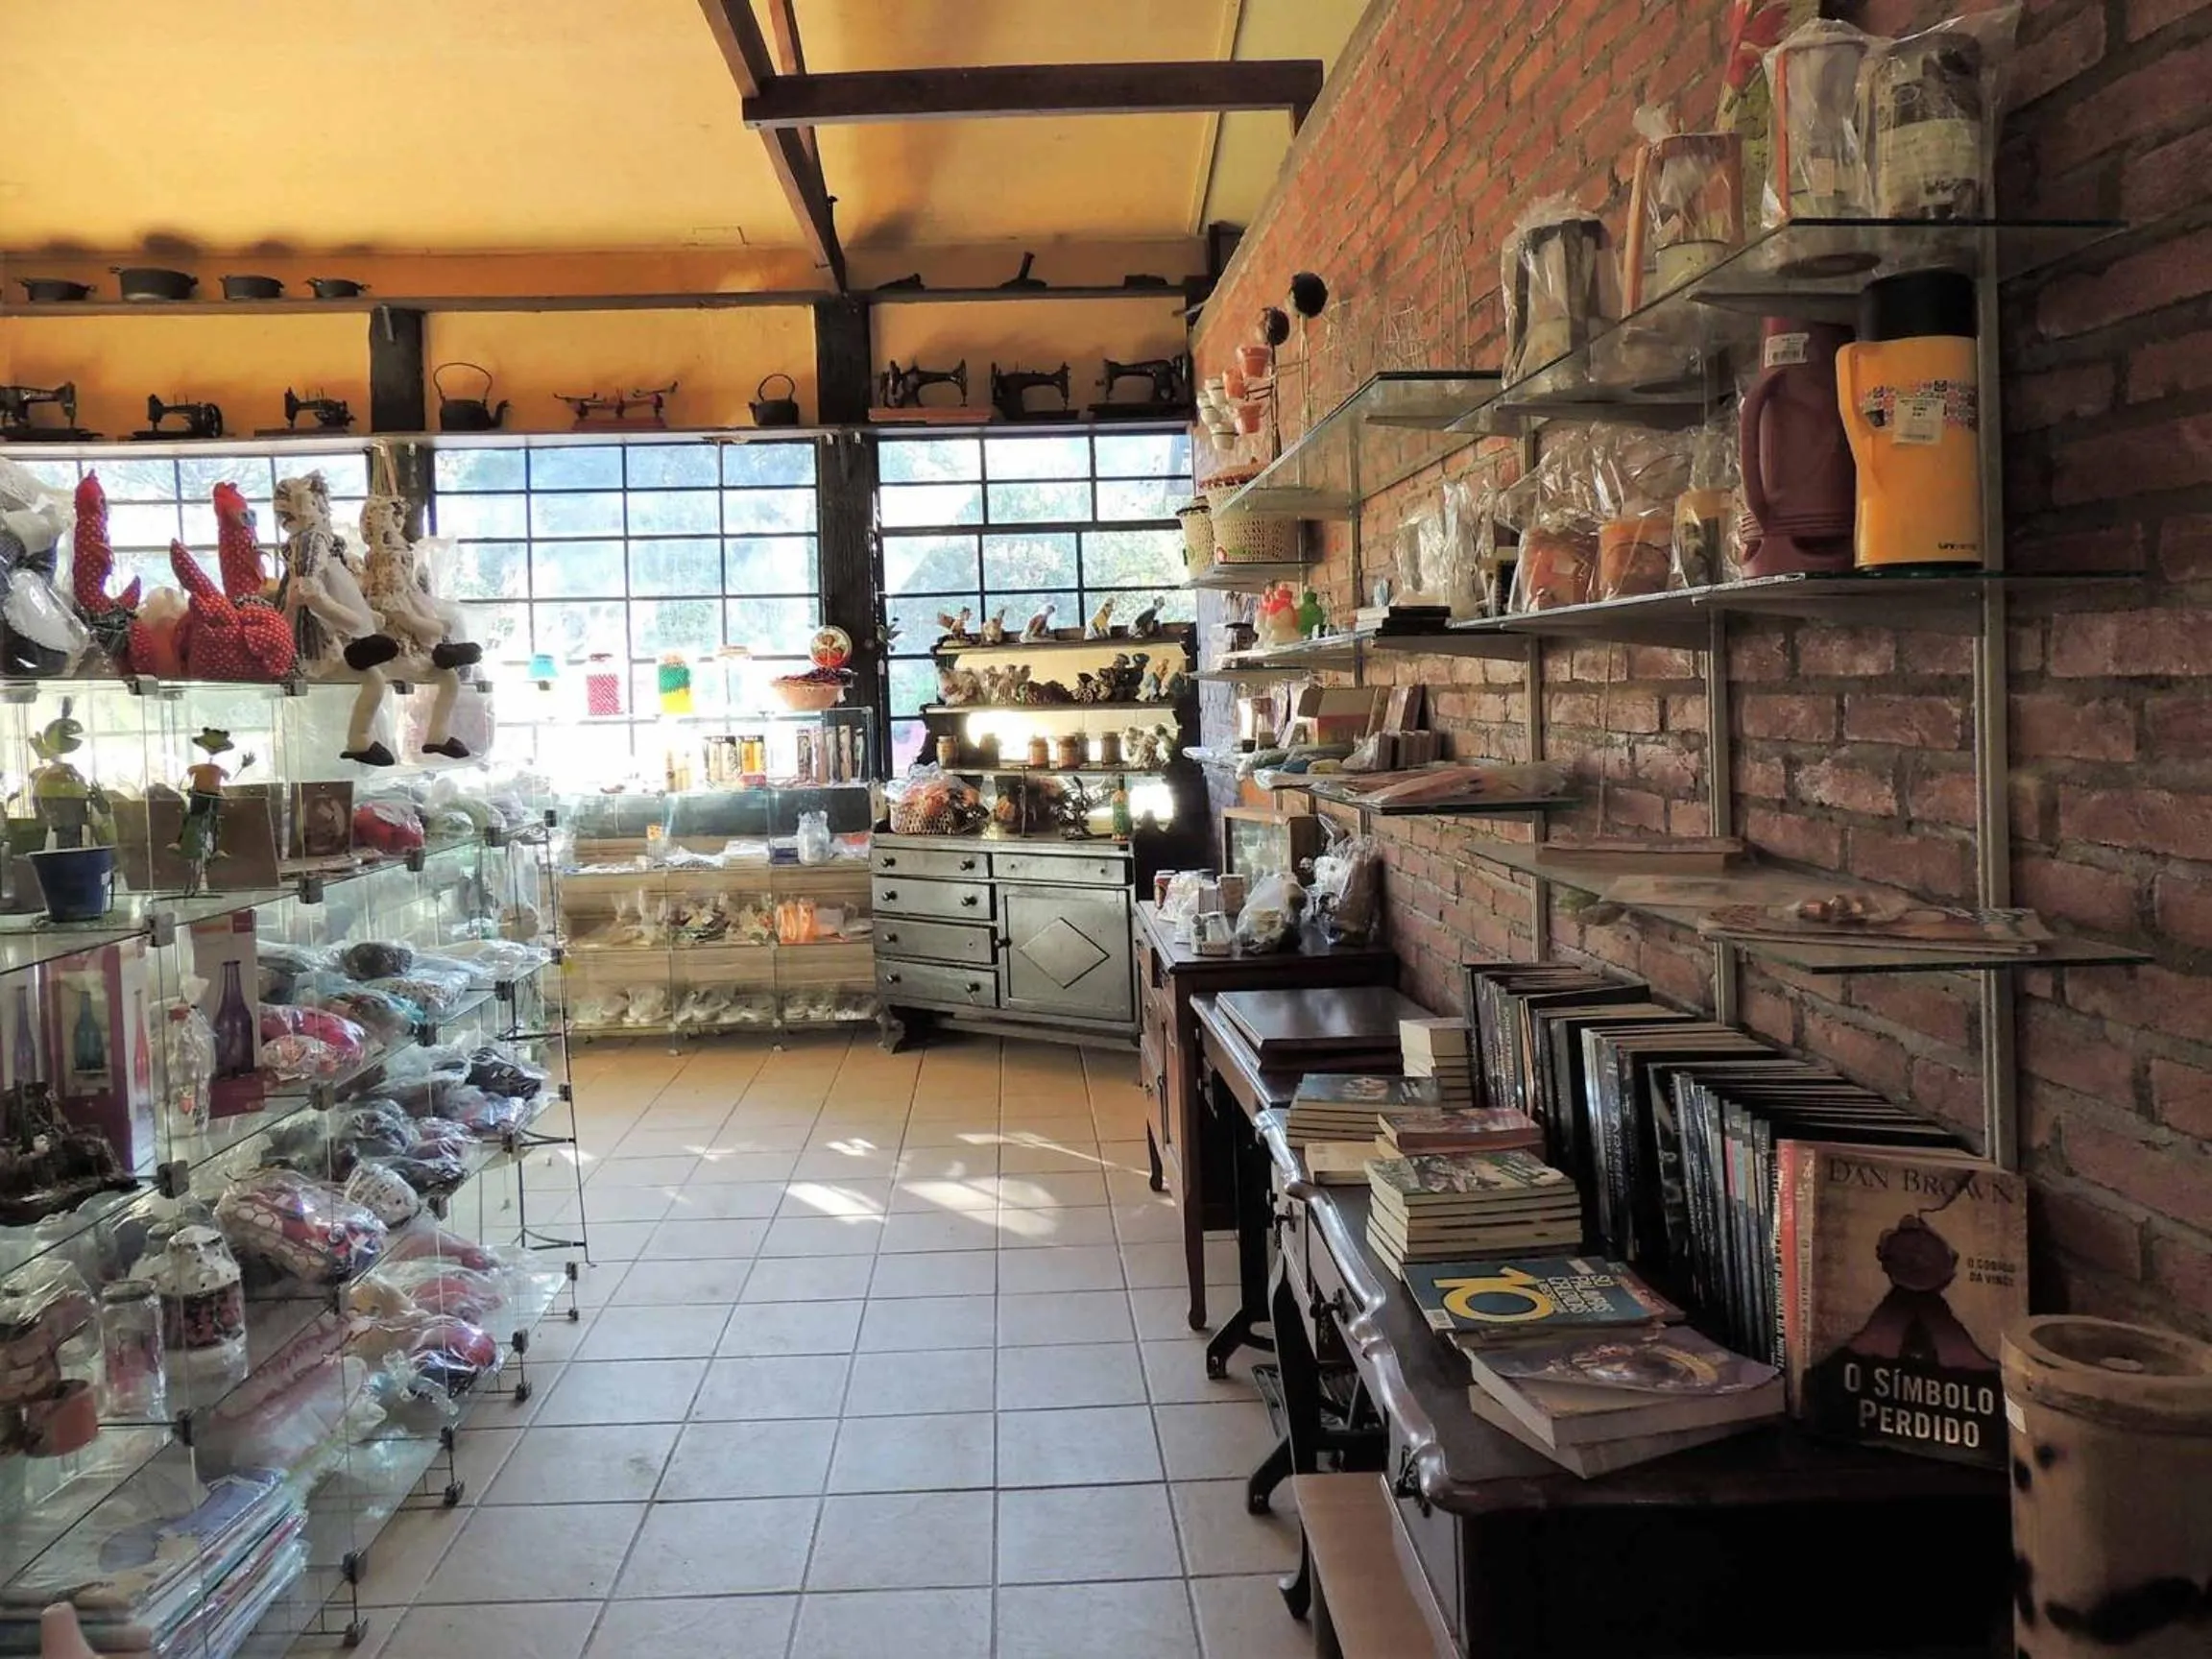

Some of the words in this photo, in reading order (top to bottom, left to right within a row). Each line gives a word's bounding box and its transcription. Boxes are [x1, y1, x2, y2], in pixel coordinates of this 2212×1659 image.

[1829, 1158, 1888, 1189] DAN
[1904, 1168, 2013, 1203] BROWN
[1433, 1265, 1554, 1322] 10
[1844, 1362, 1862, 1392] O
[1873, 1367, 1994, 1415] SÍMBOLO
[1859, 1399, 1980, 1449] PERDIDO
